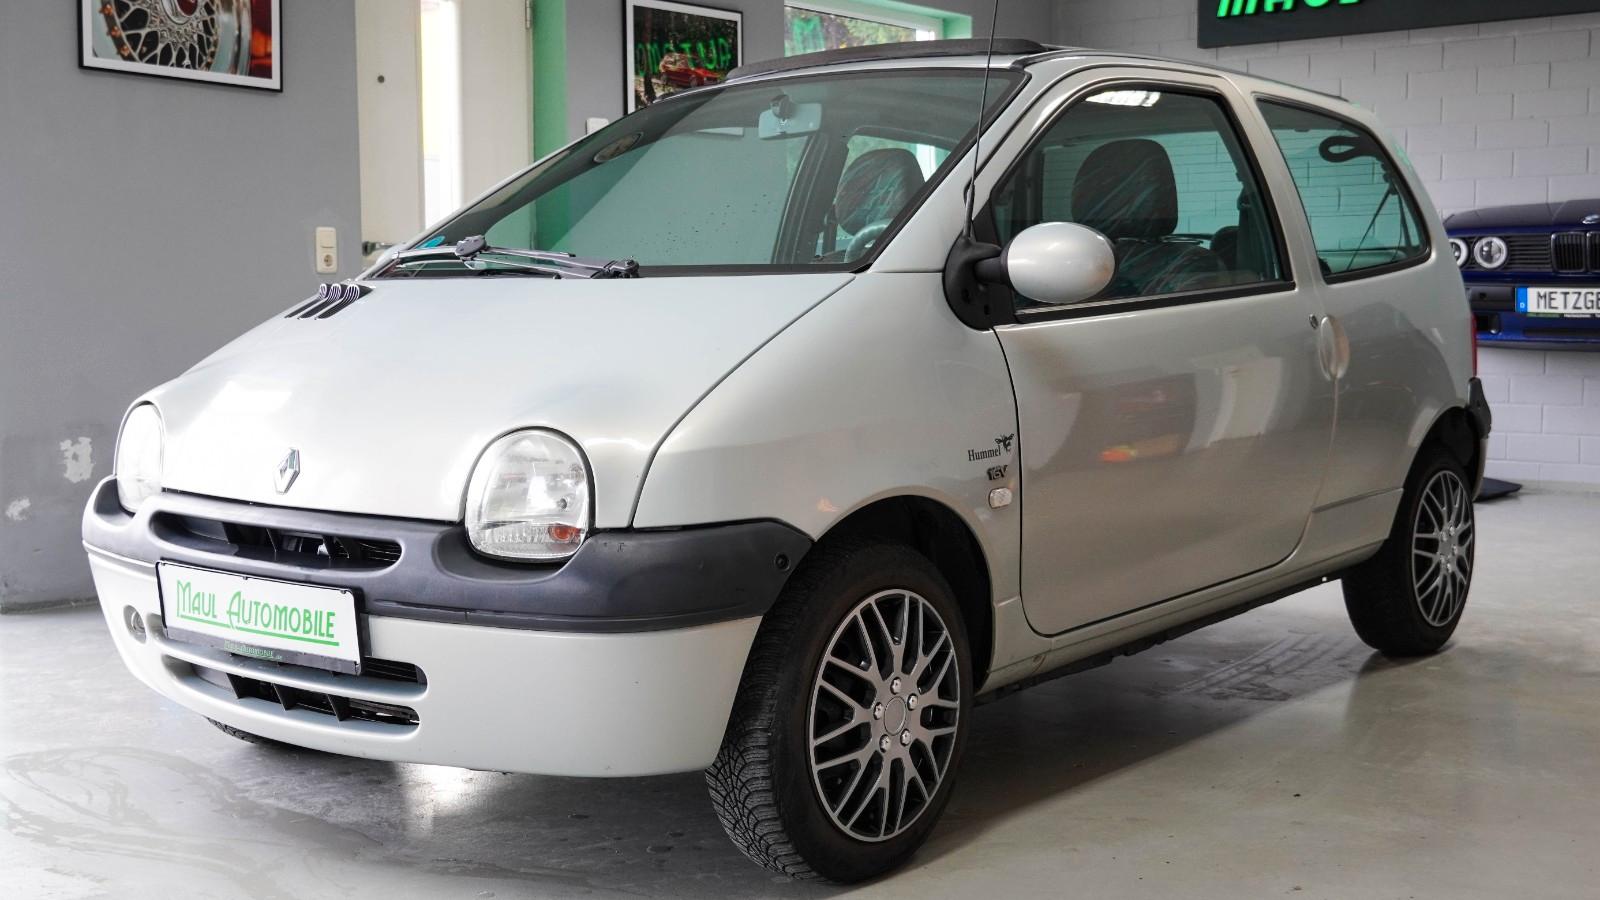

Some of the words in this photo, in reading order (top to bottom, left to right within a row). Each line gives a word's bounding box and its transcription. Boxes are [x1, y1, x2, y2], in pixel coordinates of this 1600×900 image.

[968, 445, 1001, 462] Hummel
[987, 464, 1008, 481] 16V
[177, 580, 218, 619] MAUL
[226, 591, 336, 639] AUTOMOBILE
